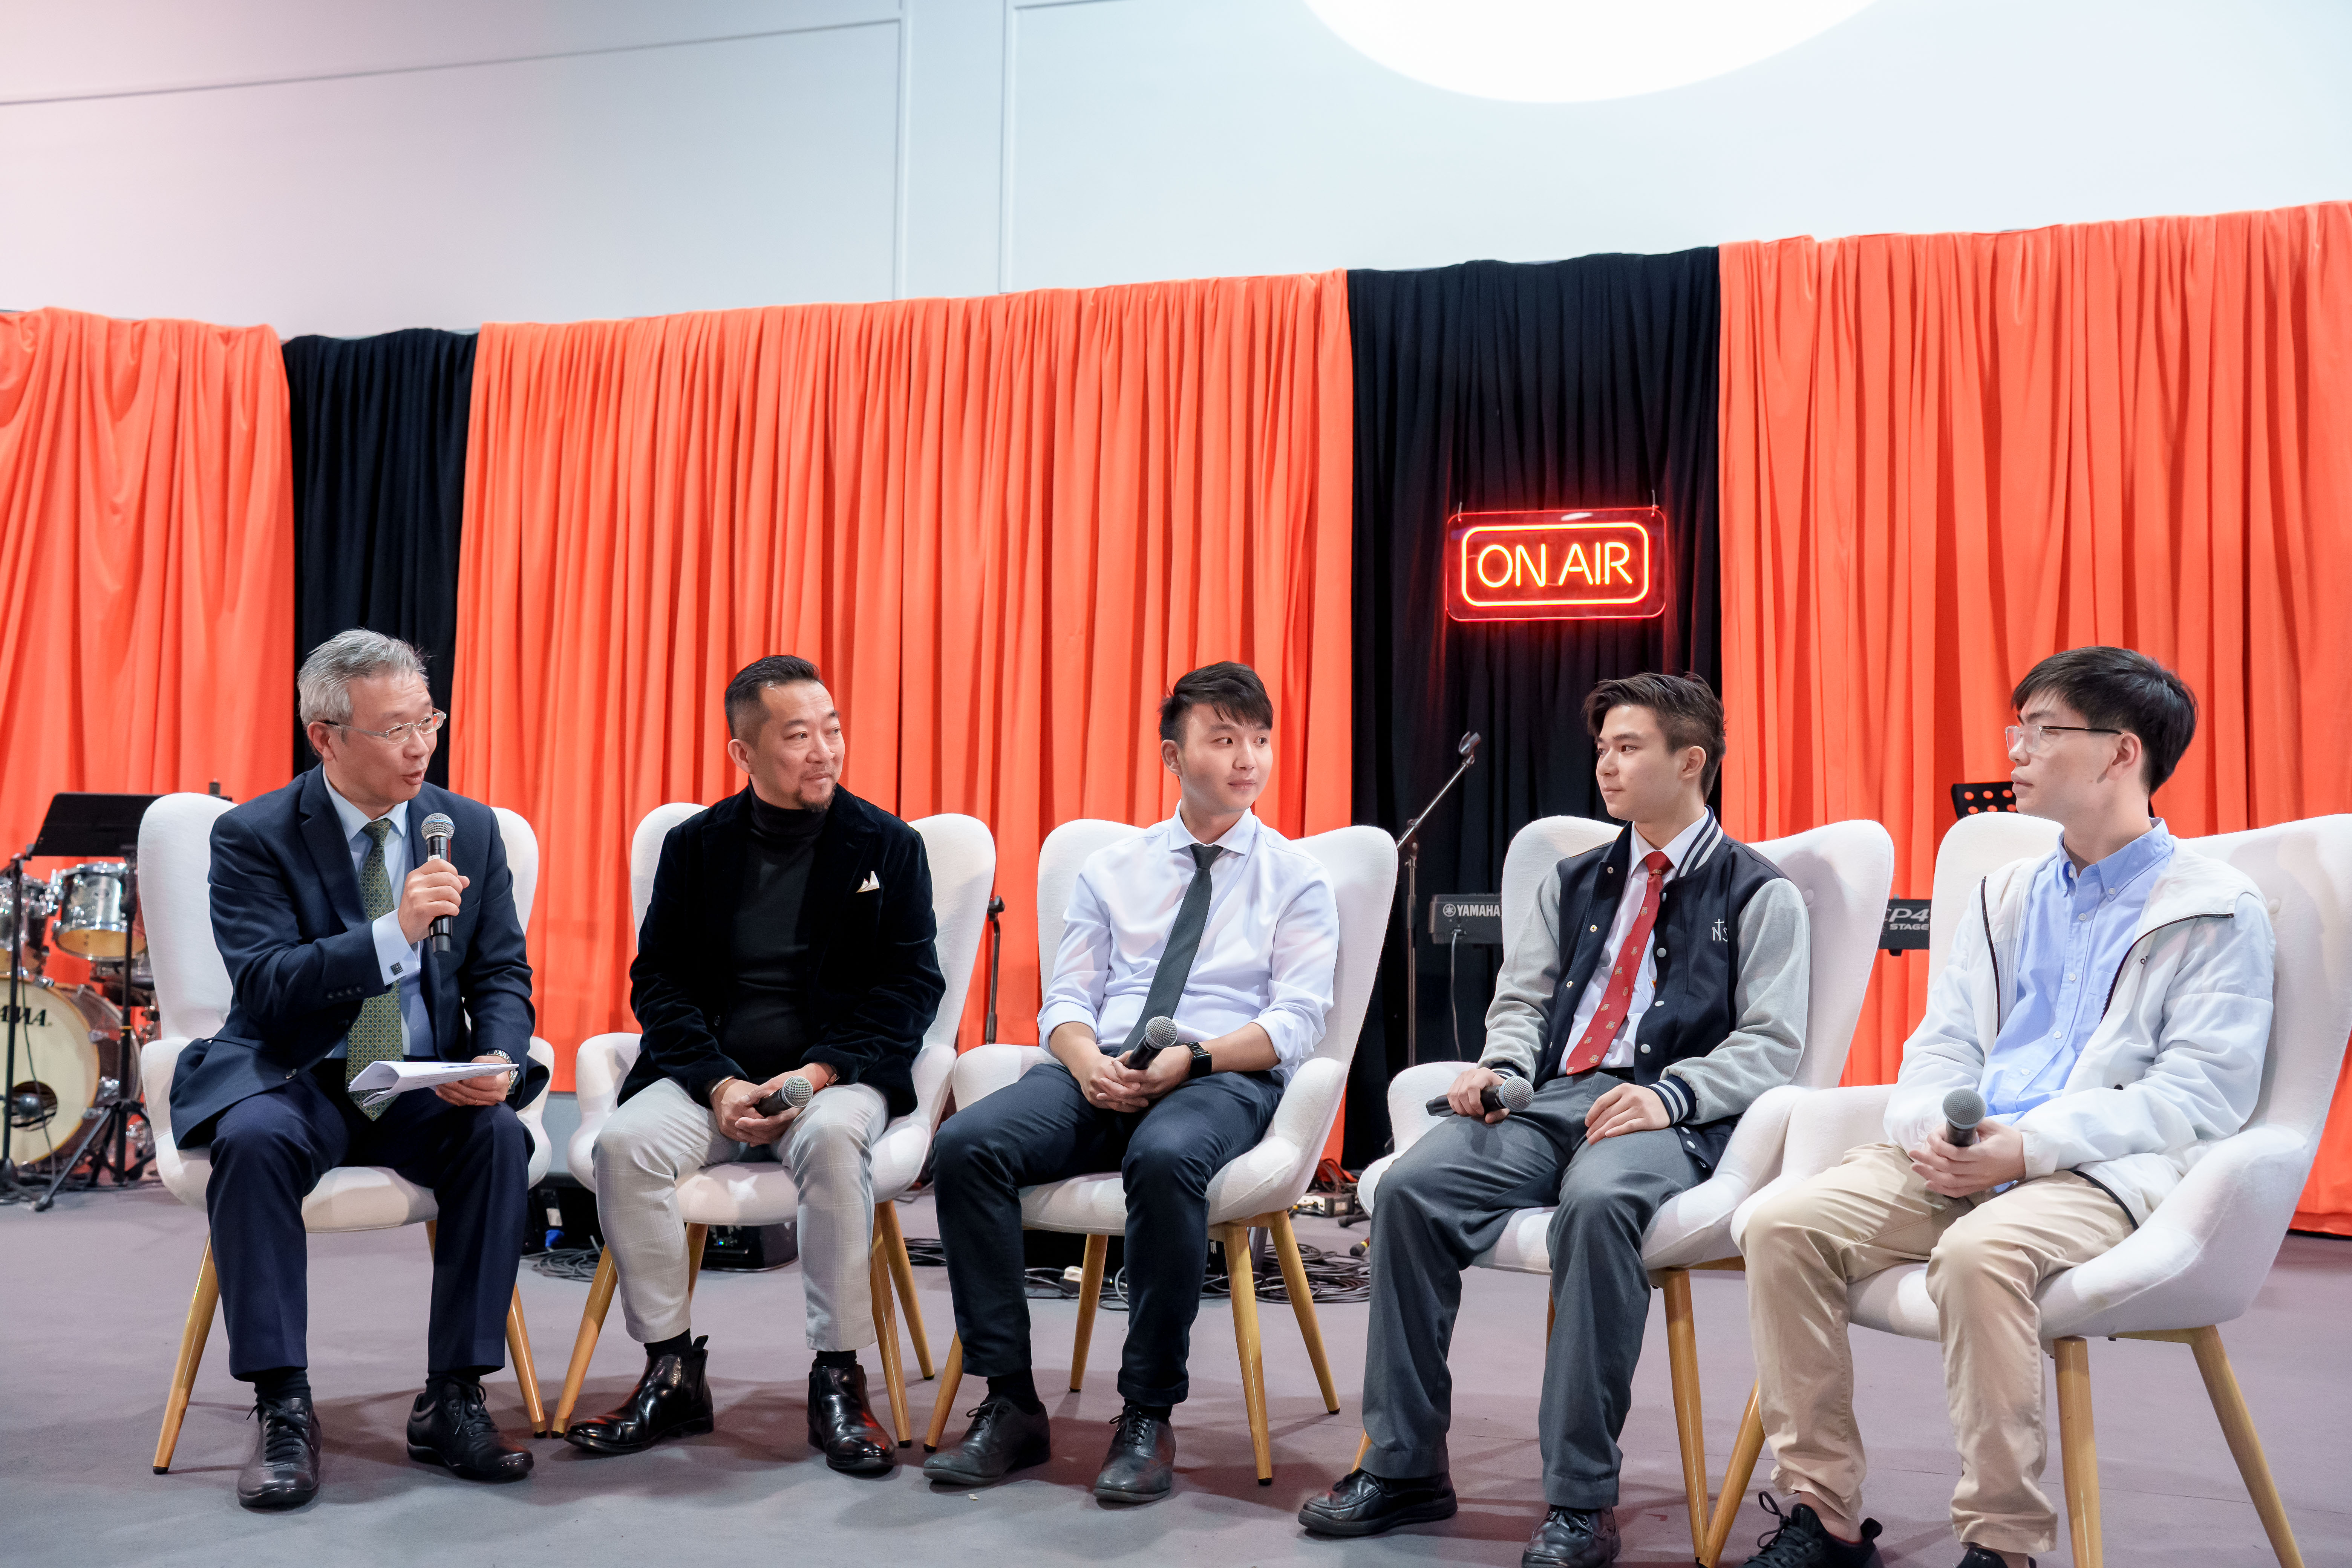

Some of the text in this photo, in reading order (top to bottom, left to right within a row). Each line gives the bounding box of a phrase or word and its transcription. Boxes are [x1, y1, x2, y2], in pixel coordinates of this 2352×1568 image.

[1477, 542, 1633, 588] ON AIR
[1457, 904, 1501, 917] YAMAHA
[1885, 908, 1929, 922] P4
